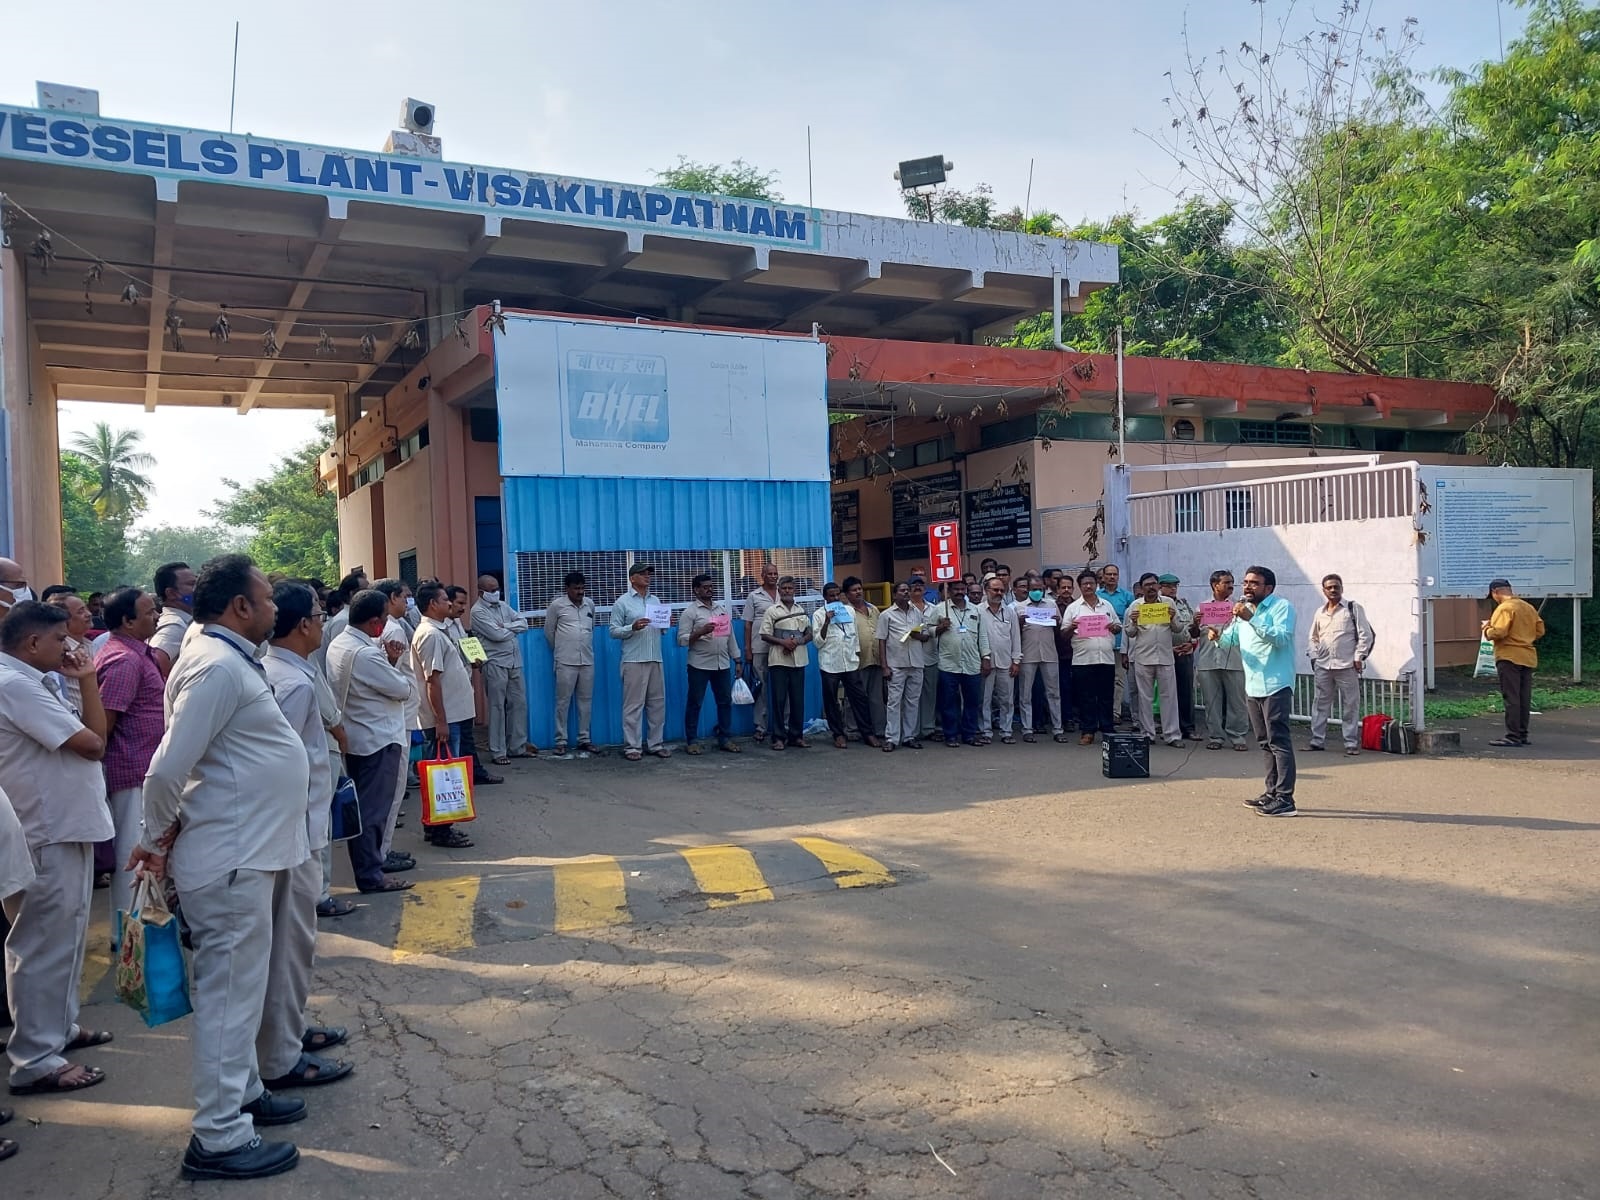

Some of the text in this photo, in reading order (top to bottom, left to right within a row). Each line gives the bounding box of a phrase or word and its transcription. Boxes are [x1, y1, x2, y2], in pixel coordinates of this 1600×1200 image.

[0, 112, 238, 175] ESSELS
[577, 380, 659, 432] BHEL
[625, 441, 667, 451] Company
[934, 525, 955, 579] CITU
